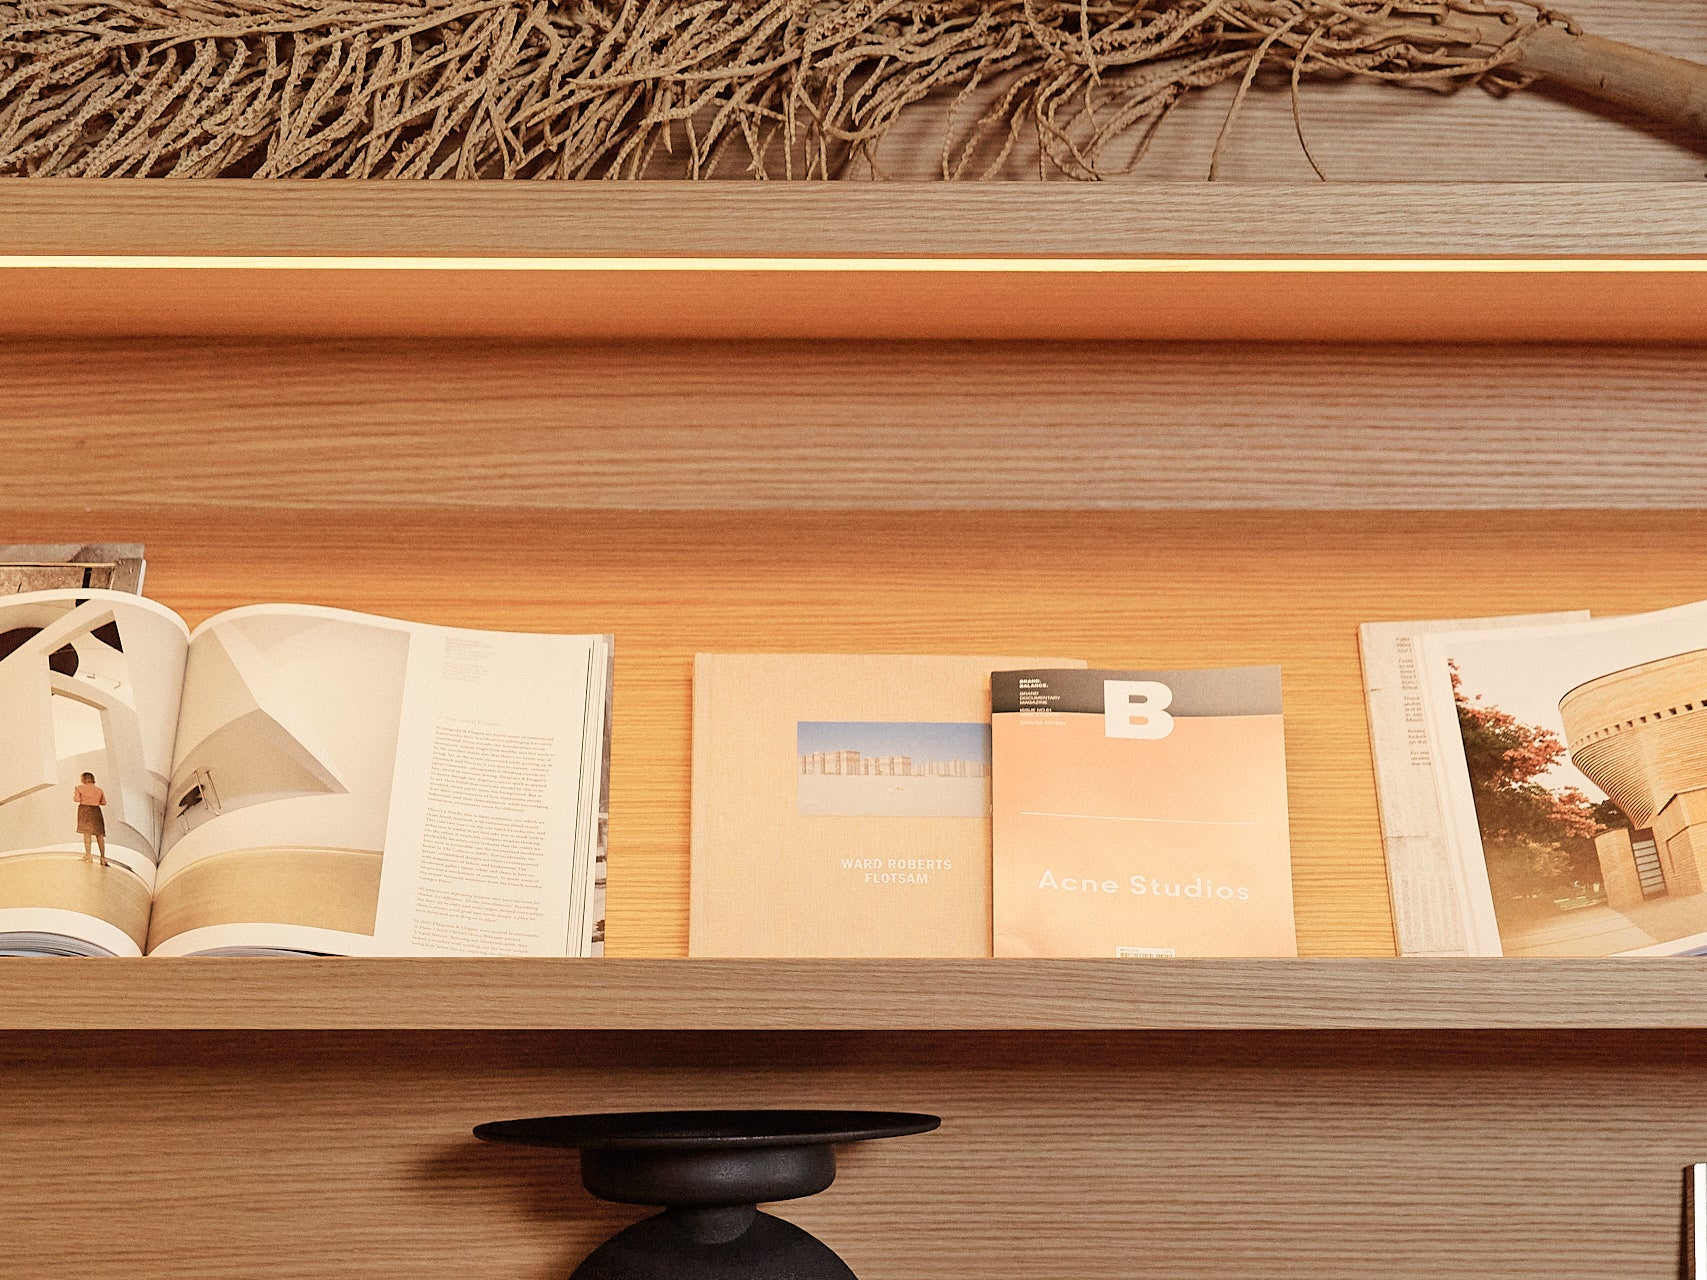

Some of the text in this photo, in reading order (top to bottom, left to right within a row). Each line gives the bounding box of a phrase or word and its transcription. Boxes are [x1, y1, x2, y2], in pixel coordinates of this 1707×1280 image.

[1104, 680, 1175, 740] B
[841, 858, 952, 871] WARD ROBERTS
[865, 872, 928, 884] FLOTSAM
[1038, 870, 1250, 902] Acne Studios
